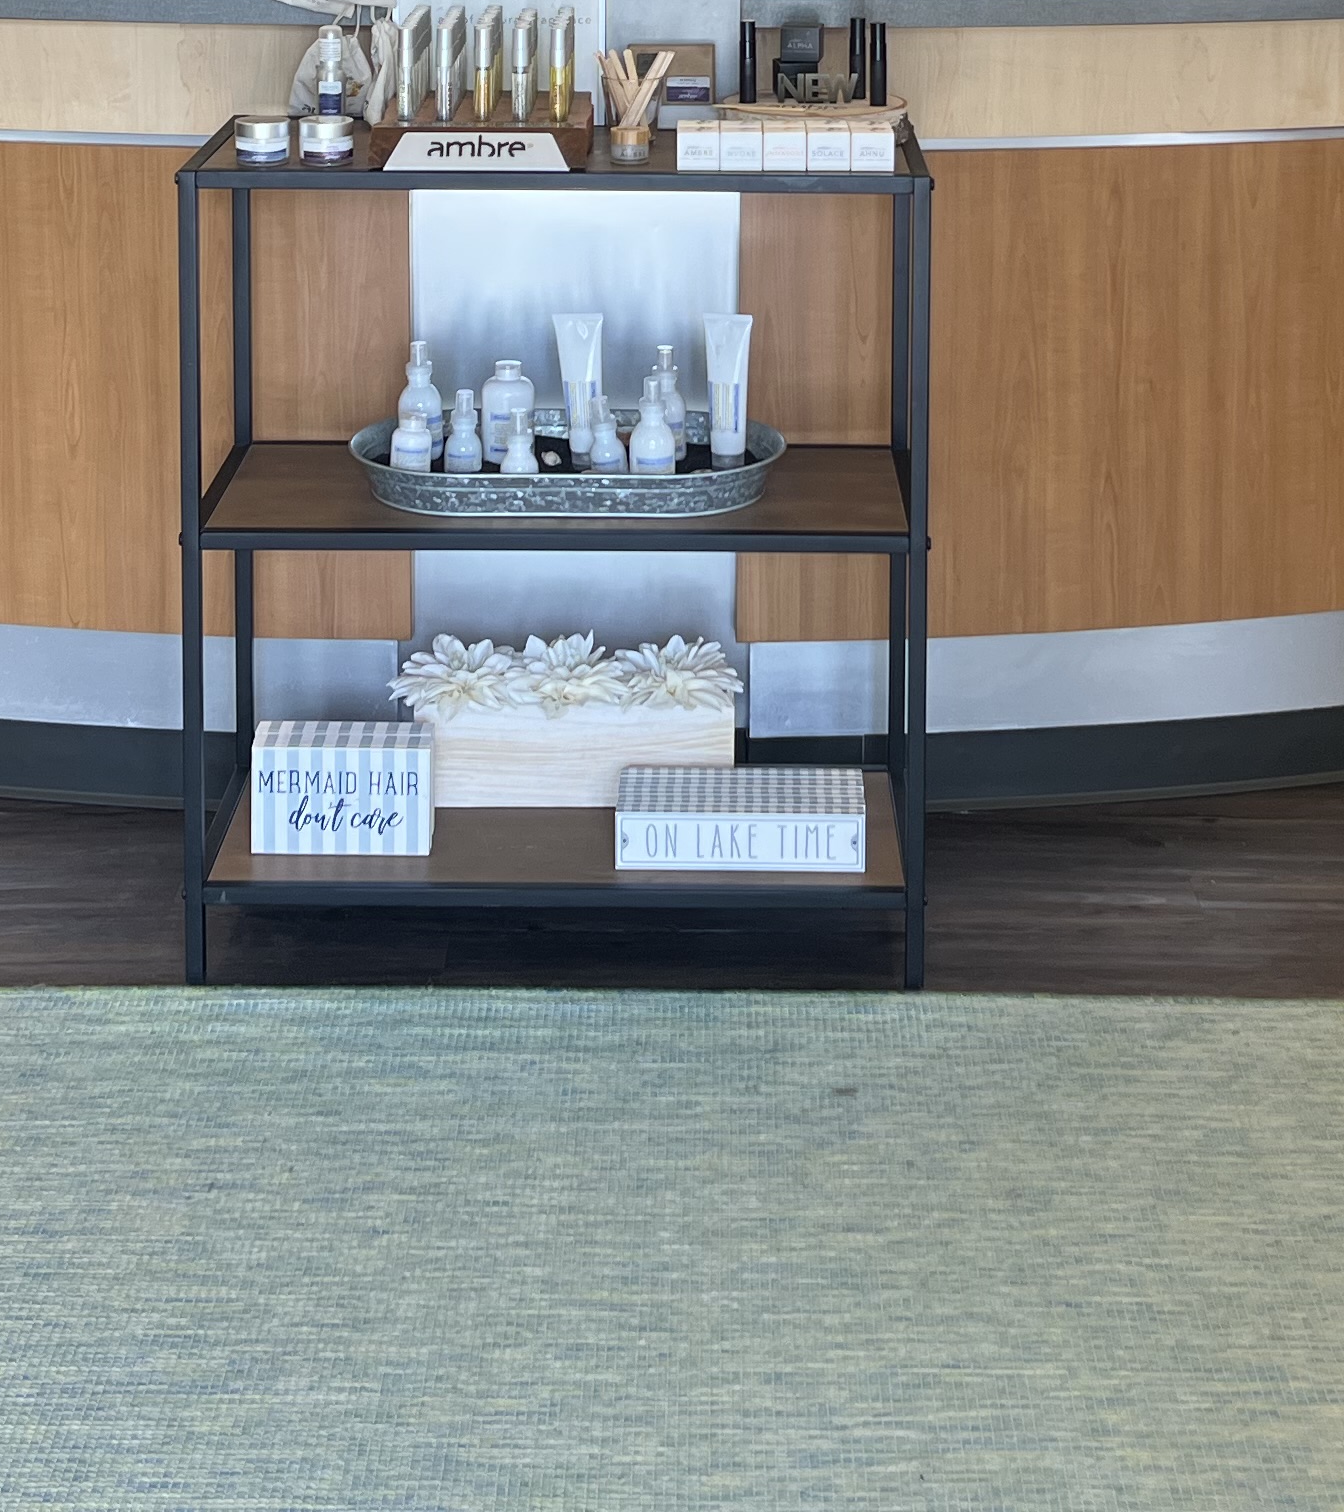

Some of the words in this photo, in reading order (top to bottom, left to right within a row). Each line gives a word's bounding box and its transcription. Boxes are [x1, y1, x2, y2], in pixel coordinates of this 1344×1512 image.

[777, 72, 859, 104] NEW
[426, 134, 527, 158] ambre
[258, 770, 357, 794] MERMAID
[368, 770, 419, 796] HAIR
[350, 808, 404, 836] care
[646, 823, 678, 858] ON
[696, 823, 759, 859] LAKE
[777, 824, 838, 860] TIME
